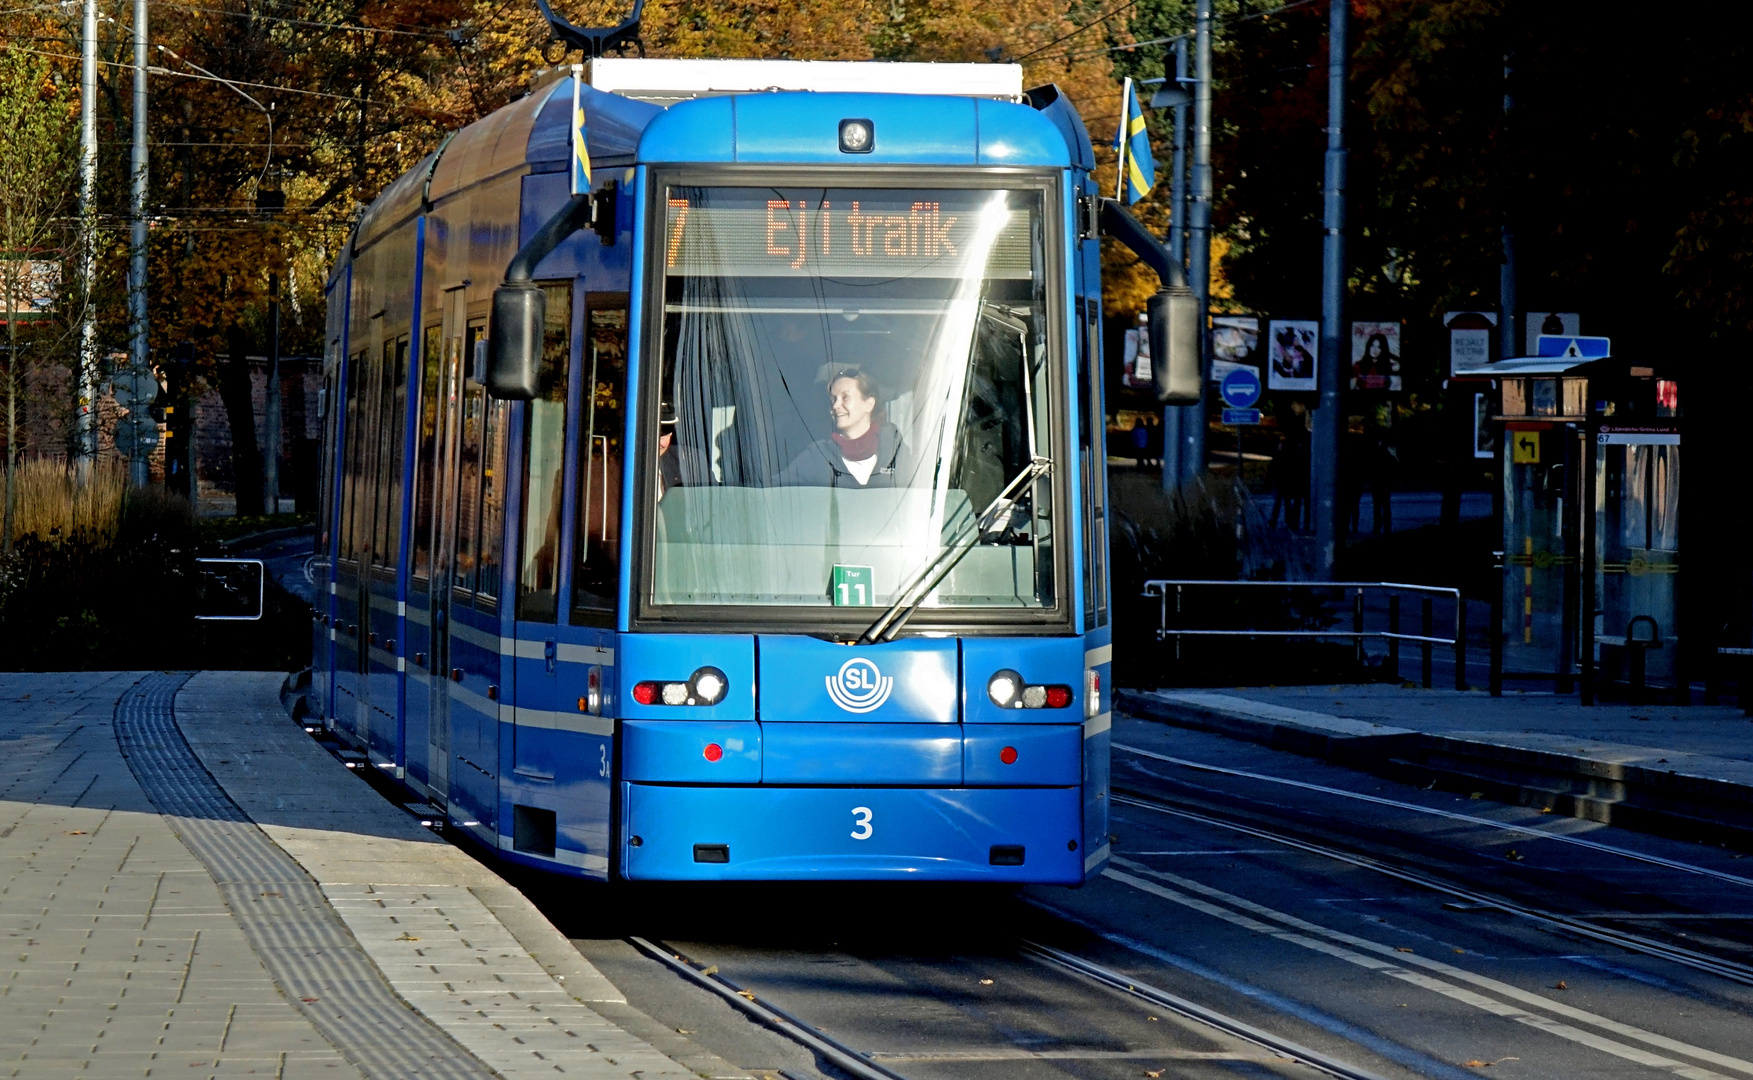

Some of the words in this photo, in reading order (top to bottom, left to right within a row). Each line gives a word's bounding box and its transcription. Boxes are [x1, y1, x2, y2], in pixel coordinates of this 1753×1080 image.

[668, 199, 689, 268] 7
[767, 200, 807, 269] Ej
[822, 201, 831, 256] i
[848, 201, 958, 256] trafik
[1598, 434, 1610, 443] 67
[837, 583, 866, 605] 11
[845, 668, 874, 690] SL
[850, 806, 873, 840] 3
